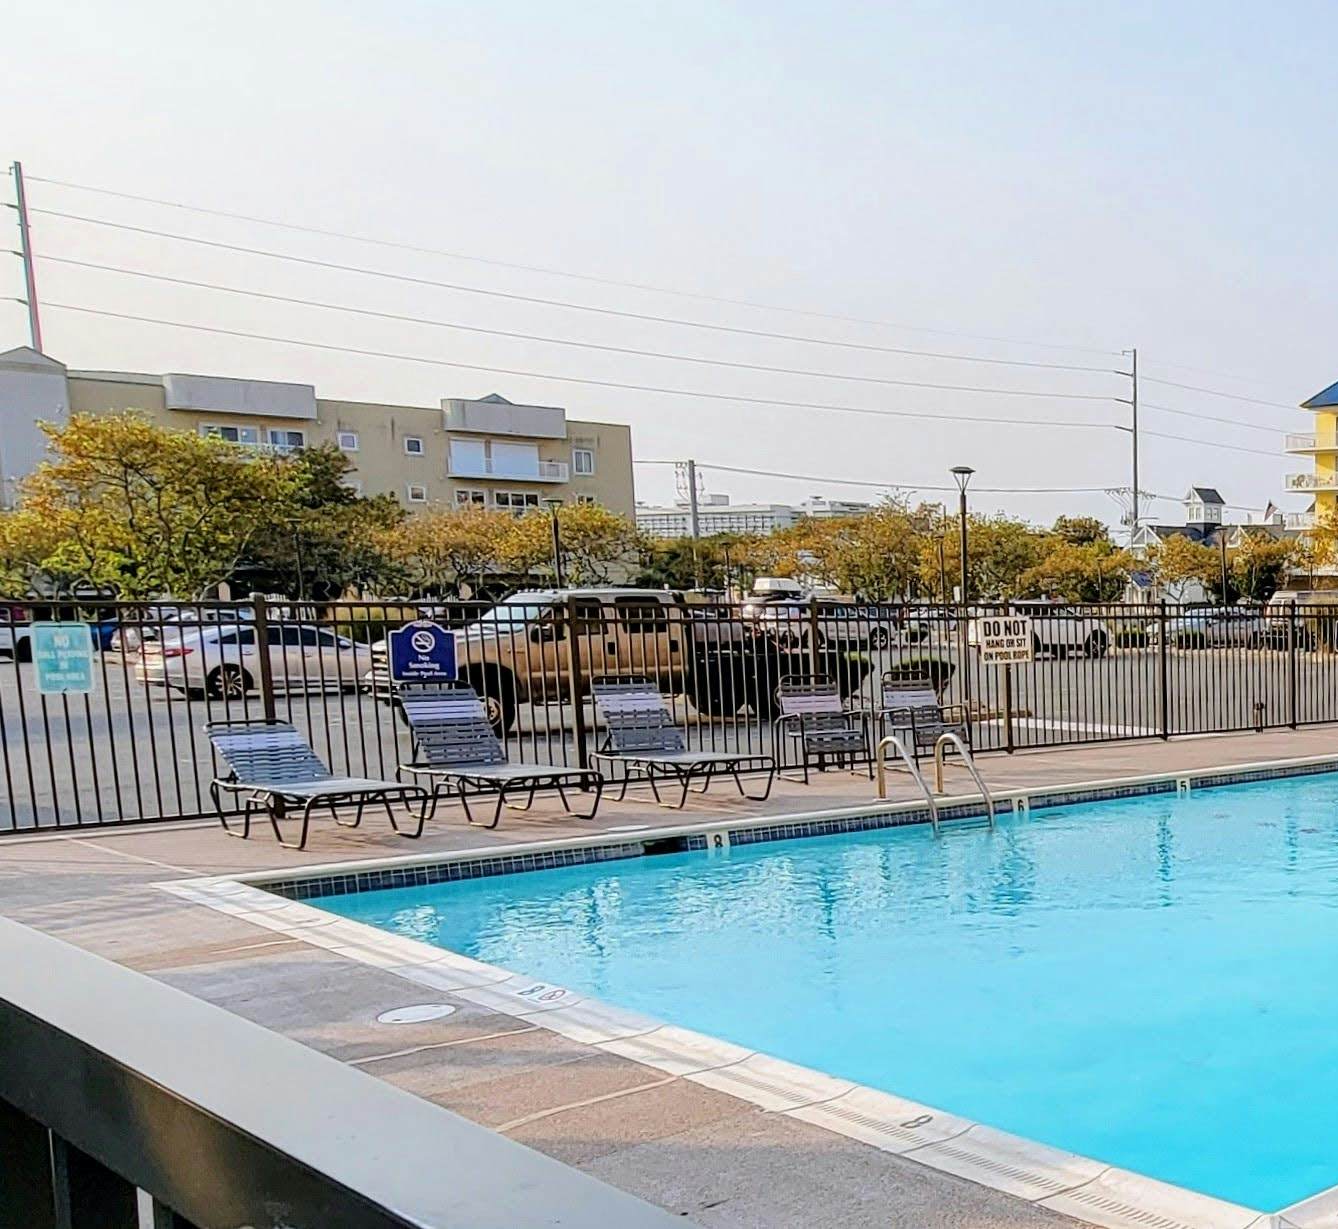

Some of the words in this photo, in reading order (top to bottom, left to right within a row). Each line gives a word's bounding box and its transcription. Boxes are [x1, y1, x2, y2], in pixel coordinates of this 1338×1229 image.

[983, 620, 1001, 637] DO
[1004, 620, 1027, 636] NOT
[986, 638, 1005, 648] HANG
[1006, 638, 1016, 648] OR
[1016, 638, 1026, 647] SIT
[984, 651, 994, 661] ON
[995, 650, 1012, 661] POOL
[1013, 650, 1029, 660] ROPE
[408, 662, 440, 671] Smoking
[1180, 780, 1187, 792] 5
[1018, 799, 1024, 811] 6
[714, 834, 723, 848] 8
